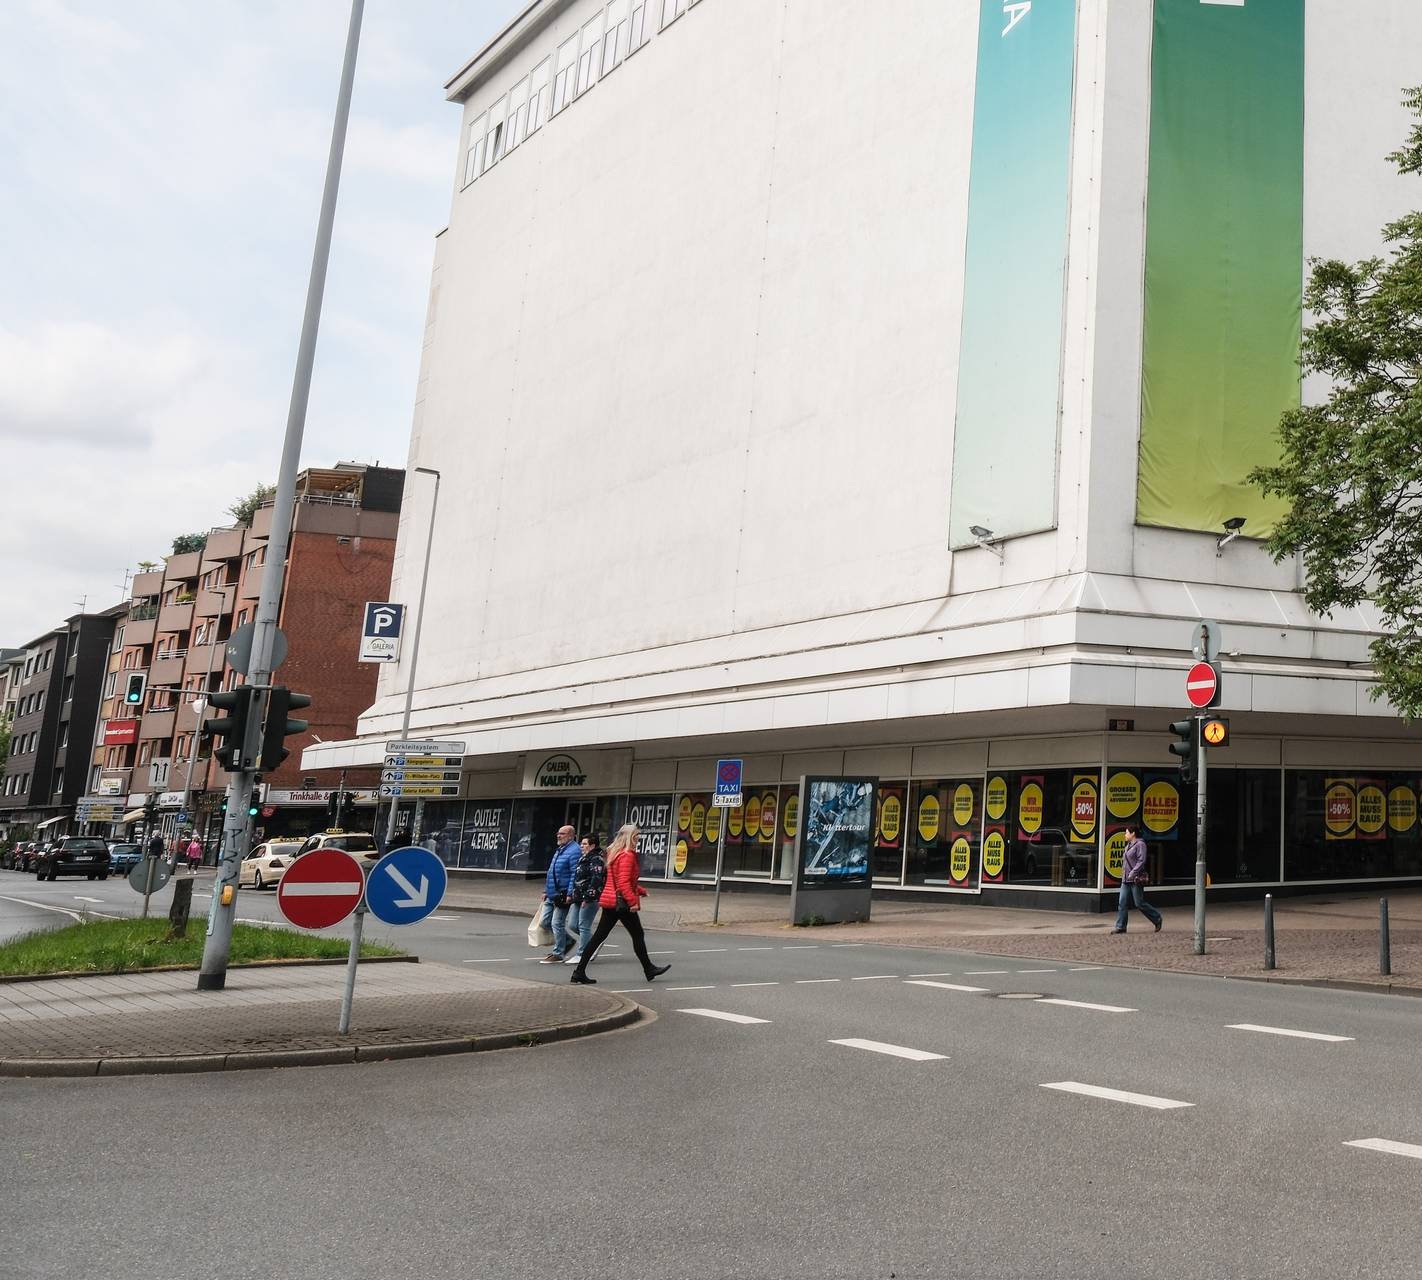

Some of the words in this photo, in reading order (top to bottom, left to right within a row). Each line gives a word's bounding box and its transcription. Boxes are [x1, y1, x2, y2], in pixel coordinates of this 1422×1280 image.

[546, 762, 570, 772] GALERIA
[290, 792, 322, 800] Trinkhalle
[1144, 797, 1177, 808] ALLES
[1076, 802, 1093, 815] -50%
[1330, 804, 1350, 814] -50%
[1360, 806, 1382, 814] MUSS
[474, 808, 502, 826] OUTLET
[630, 805, 669, 826] OUTLET
[1360, 814, 1382, 823] RAUS
[823, 823, 866, 832] Klttertour
[1110, 841, 1126, 849] ALL
